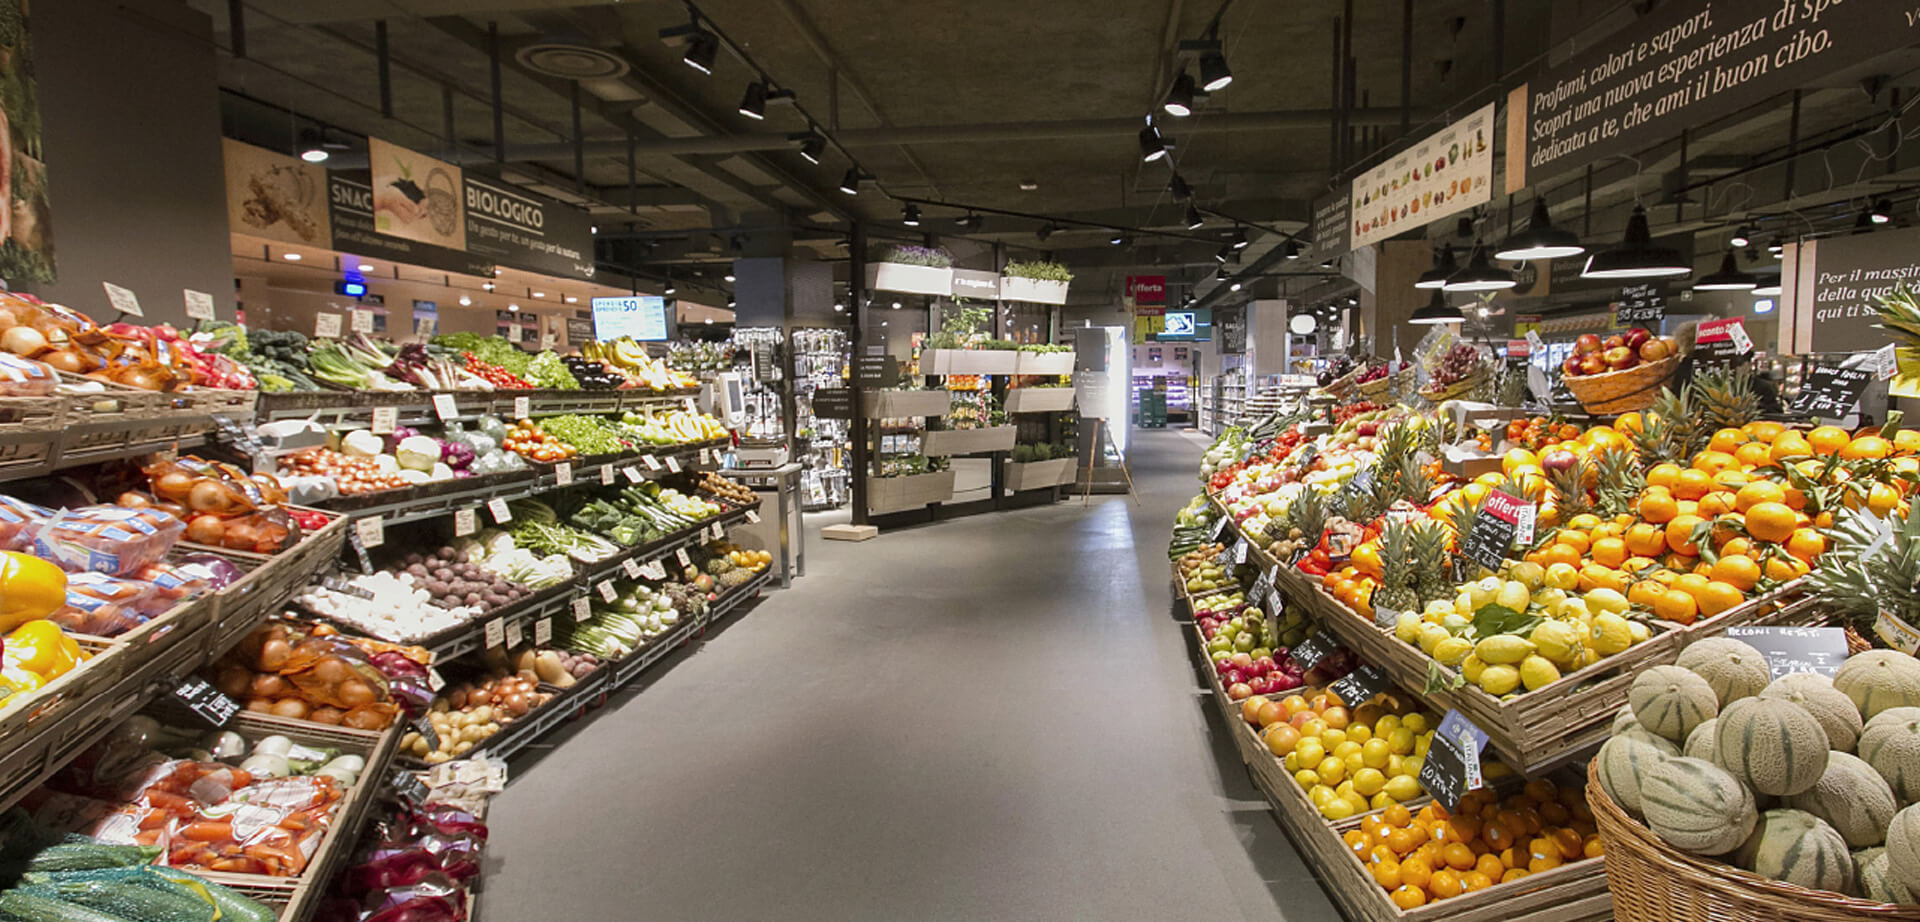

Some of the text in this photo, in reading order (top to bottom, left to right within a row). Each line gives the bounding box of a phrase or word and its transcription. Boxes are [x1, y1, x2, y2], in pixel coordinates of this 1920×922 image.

[1531, 0, 1843, 141] Scopri una nuova esperienza di sp
[1533, 2, 1713, 115] Profumi, colori e sapori.
[1531, 28, 1833, 168] dedicata a te, che ami il buon cibo.
[332, 184, 373, 210] SNAC
[466, 186, 543, 228] BIOLOGICO
[1818, 272, 1847, 285] Per
[1849, 269, 1861, 282] il
[623, 300, 638, 312] 50
[1817, 286, 1857, 302] della
[1816, 305, 1843, 323] qui
[1846, 303, 1860, 317] ti
[1487, 495, 1521, 519] offert
